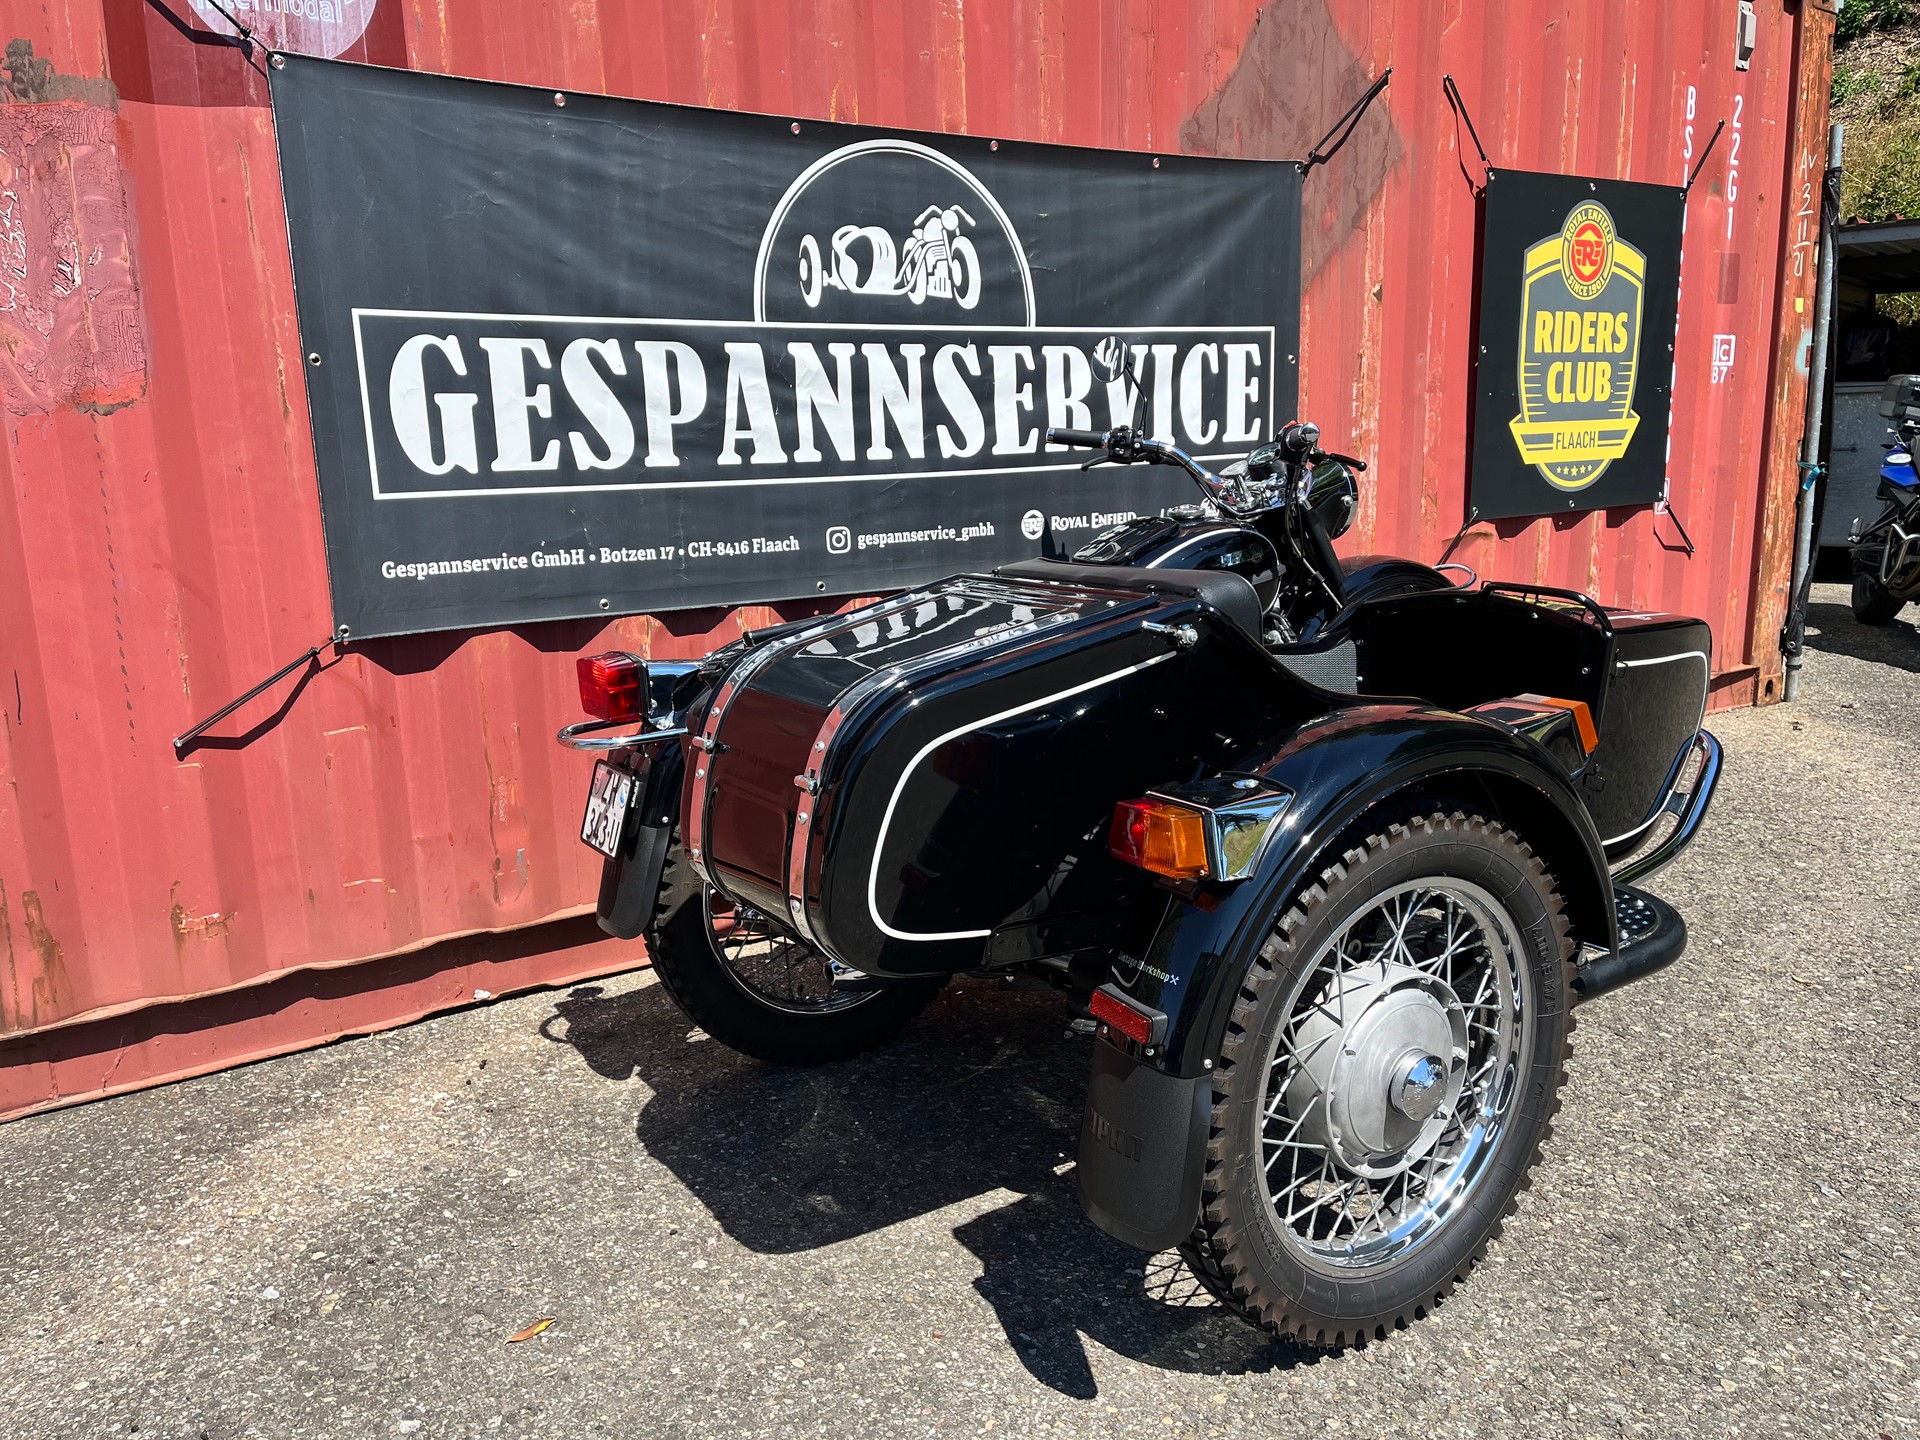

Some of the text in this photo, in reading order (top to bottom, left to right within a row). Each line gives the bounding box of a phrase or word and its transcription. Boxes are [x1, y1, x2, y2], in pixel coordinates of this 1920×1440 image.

[1727, 94, 1743, 239] 22G1
[1565, 209, 1613, 243] ROYAL ENFIELD
[1567, 275, 1606, 297] SINCE 1901
[1534, 310, 1629, 353] RIDERS
[1546, 361, 1613, 404] CLUB
[1712, 366, 1728, 384] 87
[389, 333, 1262, 475] GESPANNSERVICE
[1555, 431, 1597, 450] FLAACH
[857, 521, 995, 549] gespannservice_gmbh
[1051, 511, 1137, 531] ROYAL ENFIELD
[381, 536, 800, 580] Gespannservice GmbH Botzen 17 CH-8416 Flaach
[601, 769, 621, 808] ZH
